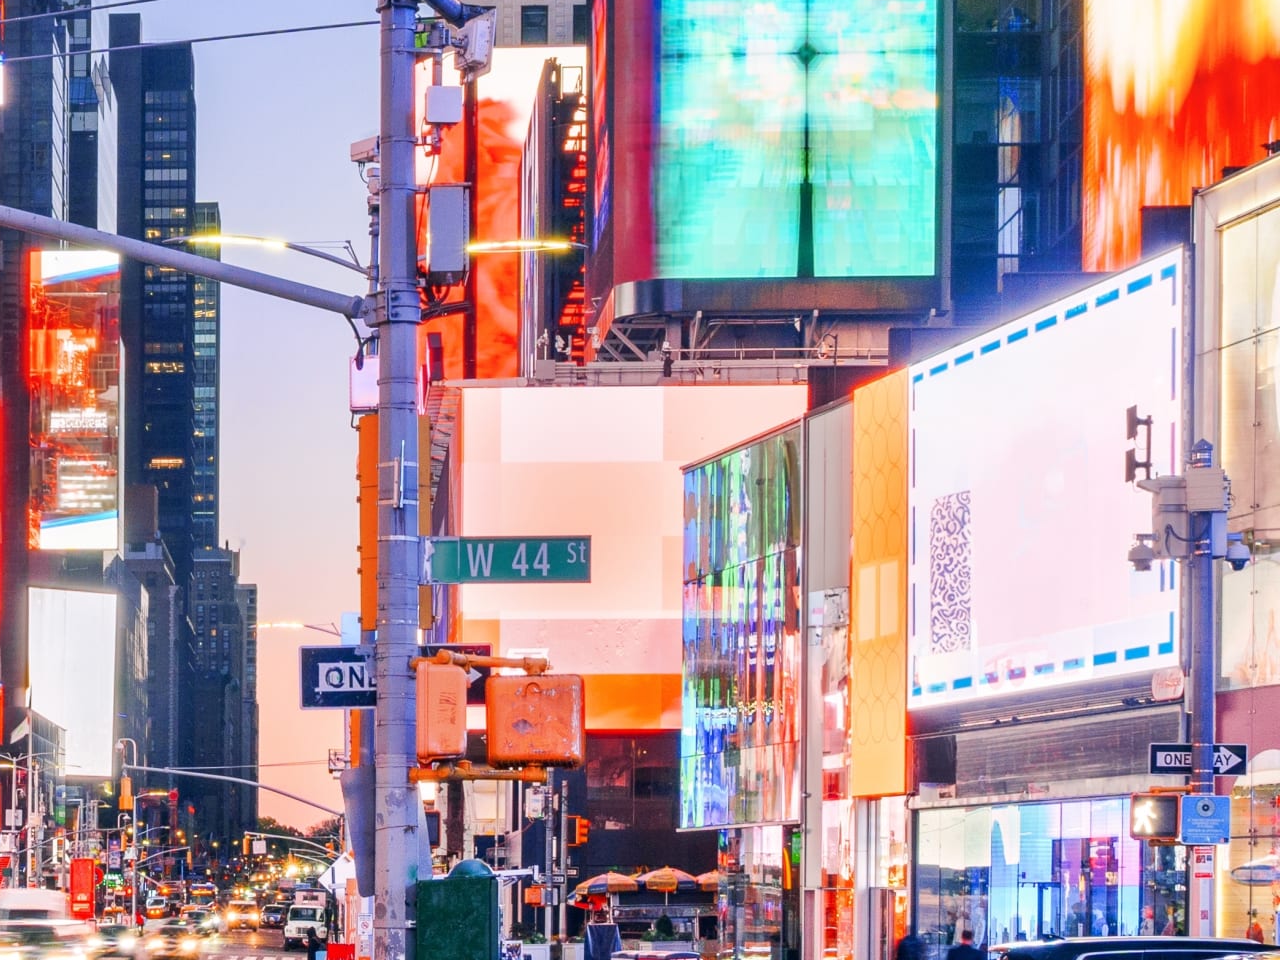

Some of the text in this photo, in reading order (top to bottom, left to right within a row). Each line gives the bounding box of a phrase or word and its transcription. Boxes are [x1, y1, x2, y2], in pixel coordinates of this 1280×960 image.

[466, 541, 586, 577] W 44 St
[1164, 753, 1233, 766] ONE AY
